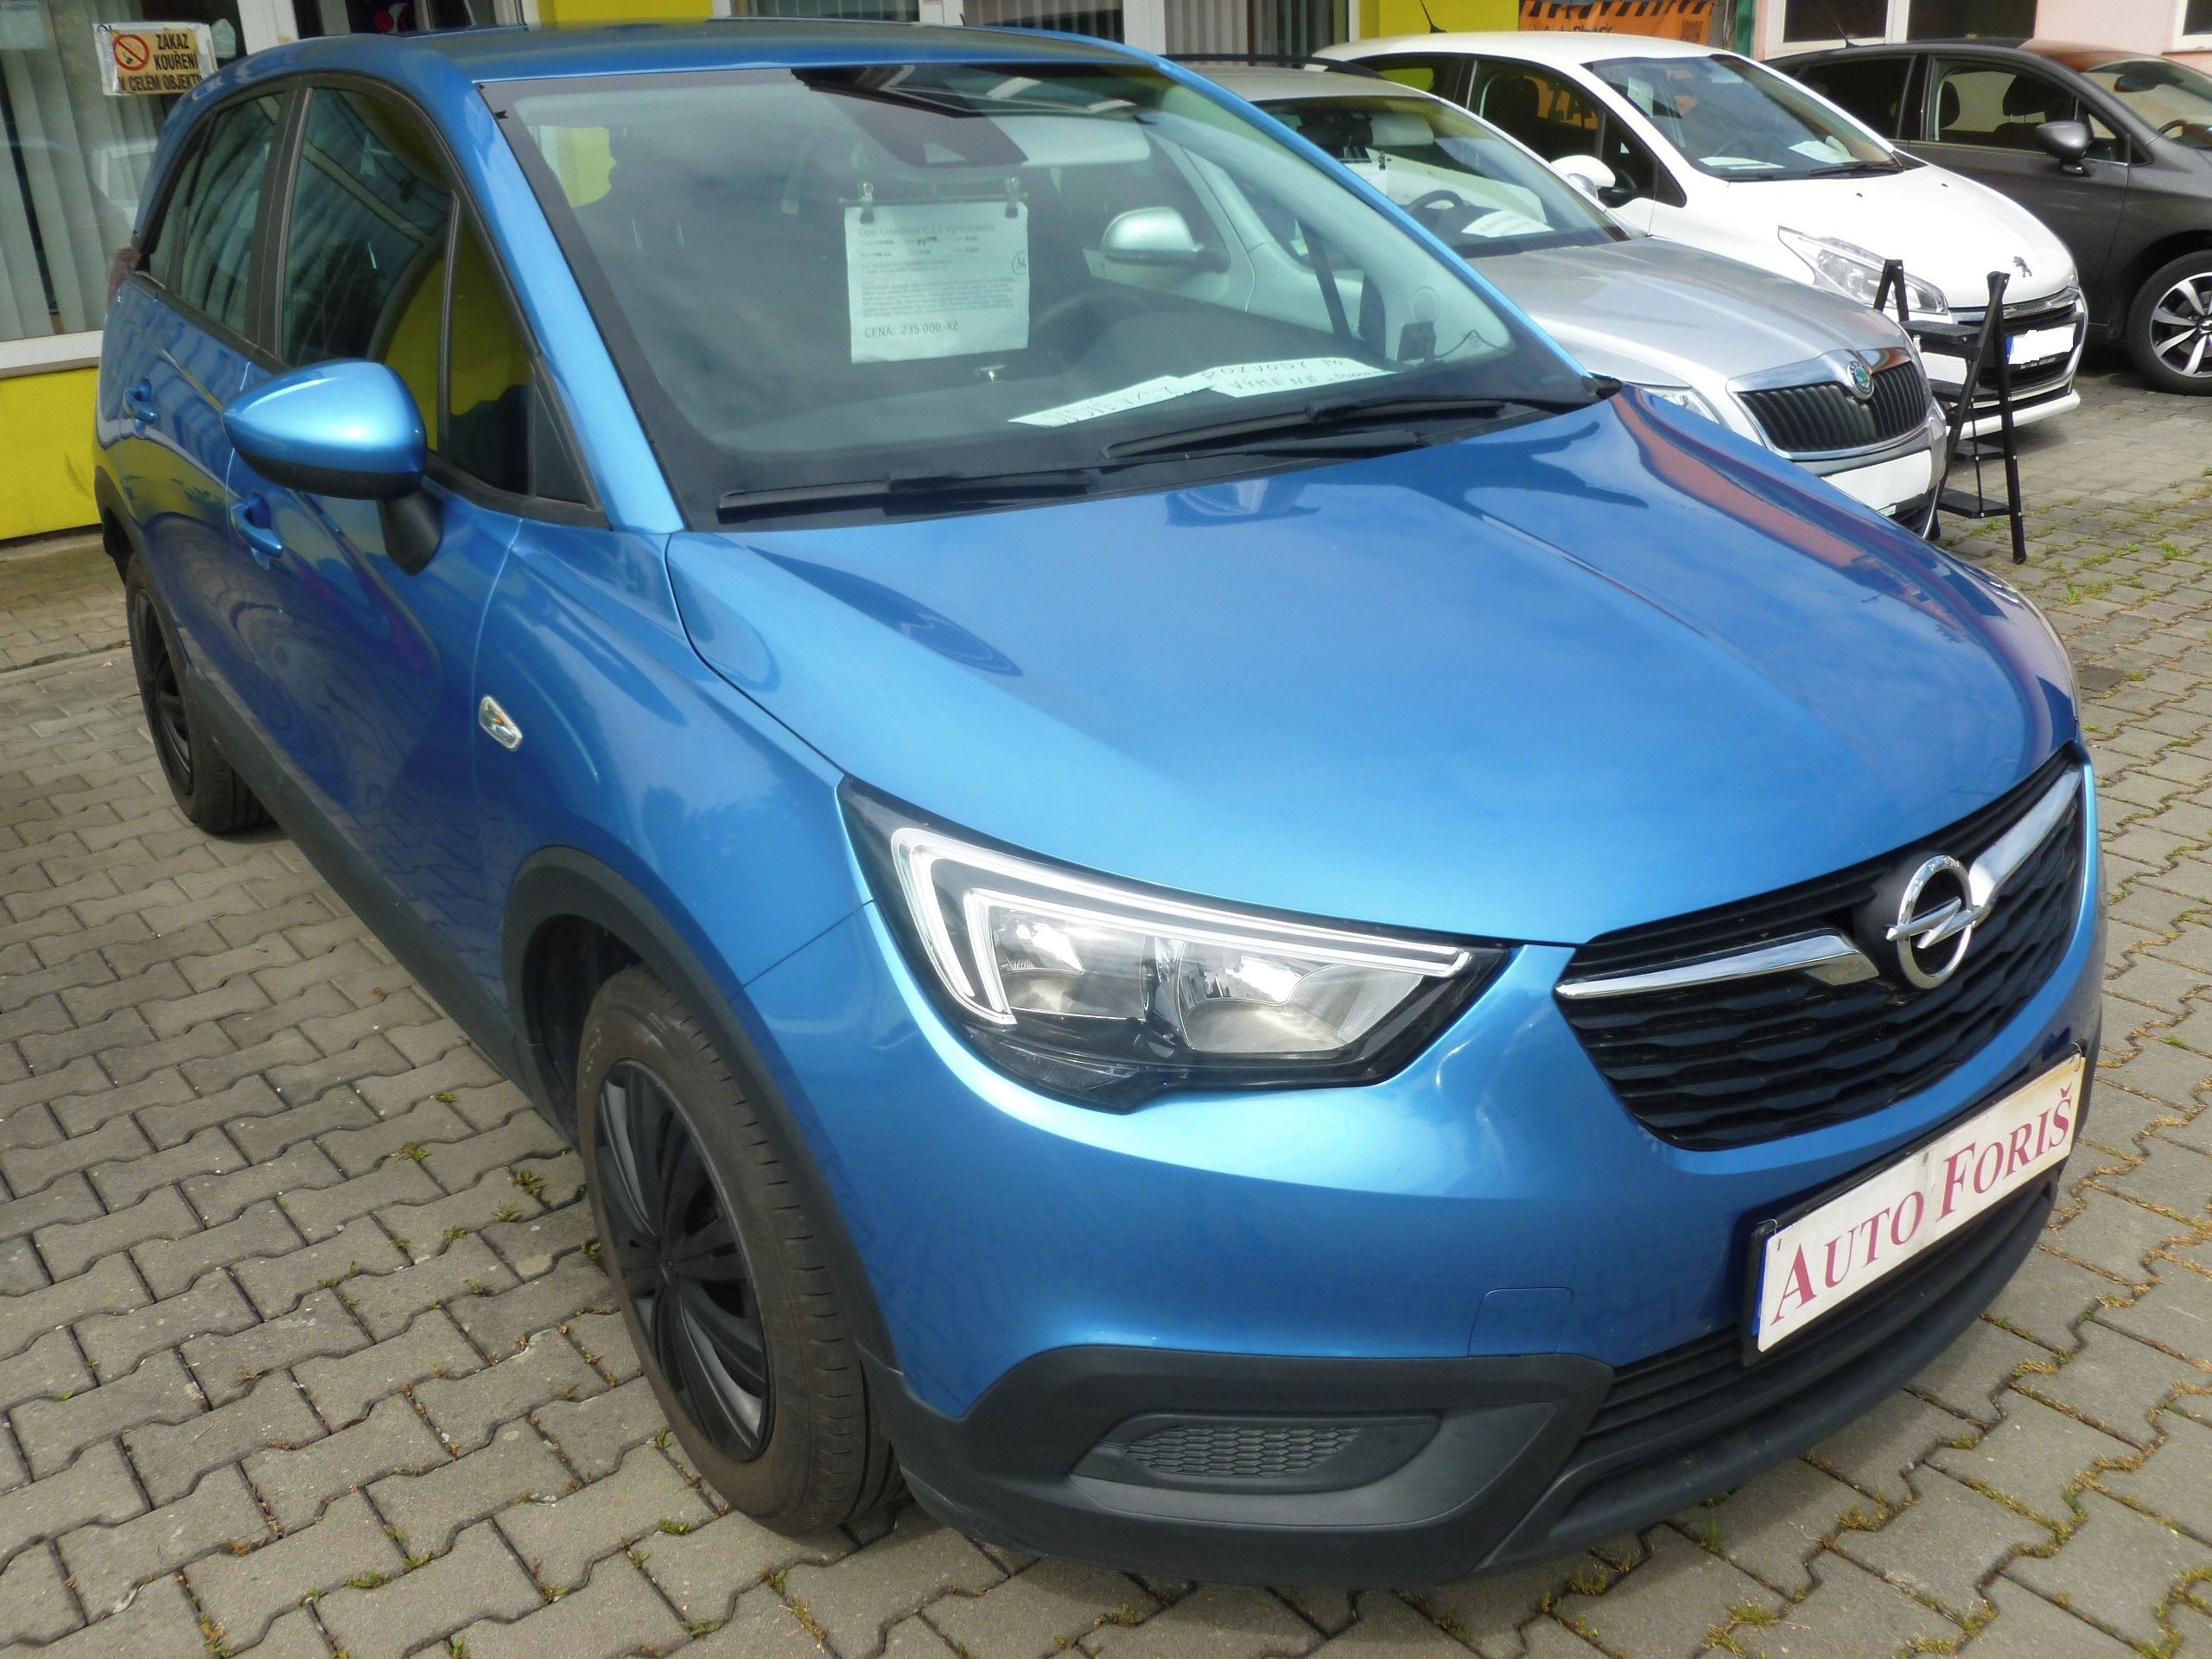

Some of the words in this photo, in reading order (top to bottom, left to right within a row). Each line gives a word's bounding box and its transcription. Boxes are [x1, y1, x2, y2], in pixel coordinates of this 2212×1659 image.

[901, 325, 919, 335] 235
[1770, 1191, 1924, 1326] AUTO
[1935, 1082, 2073, 1223] FORIŠ
